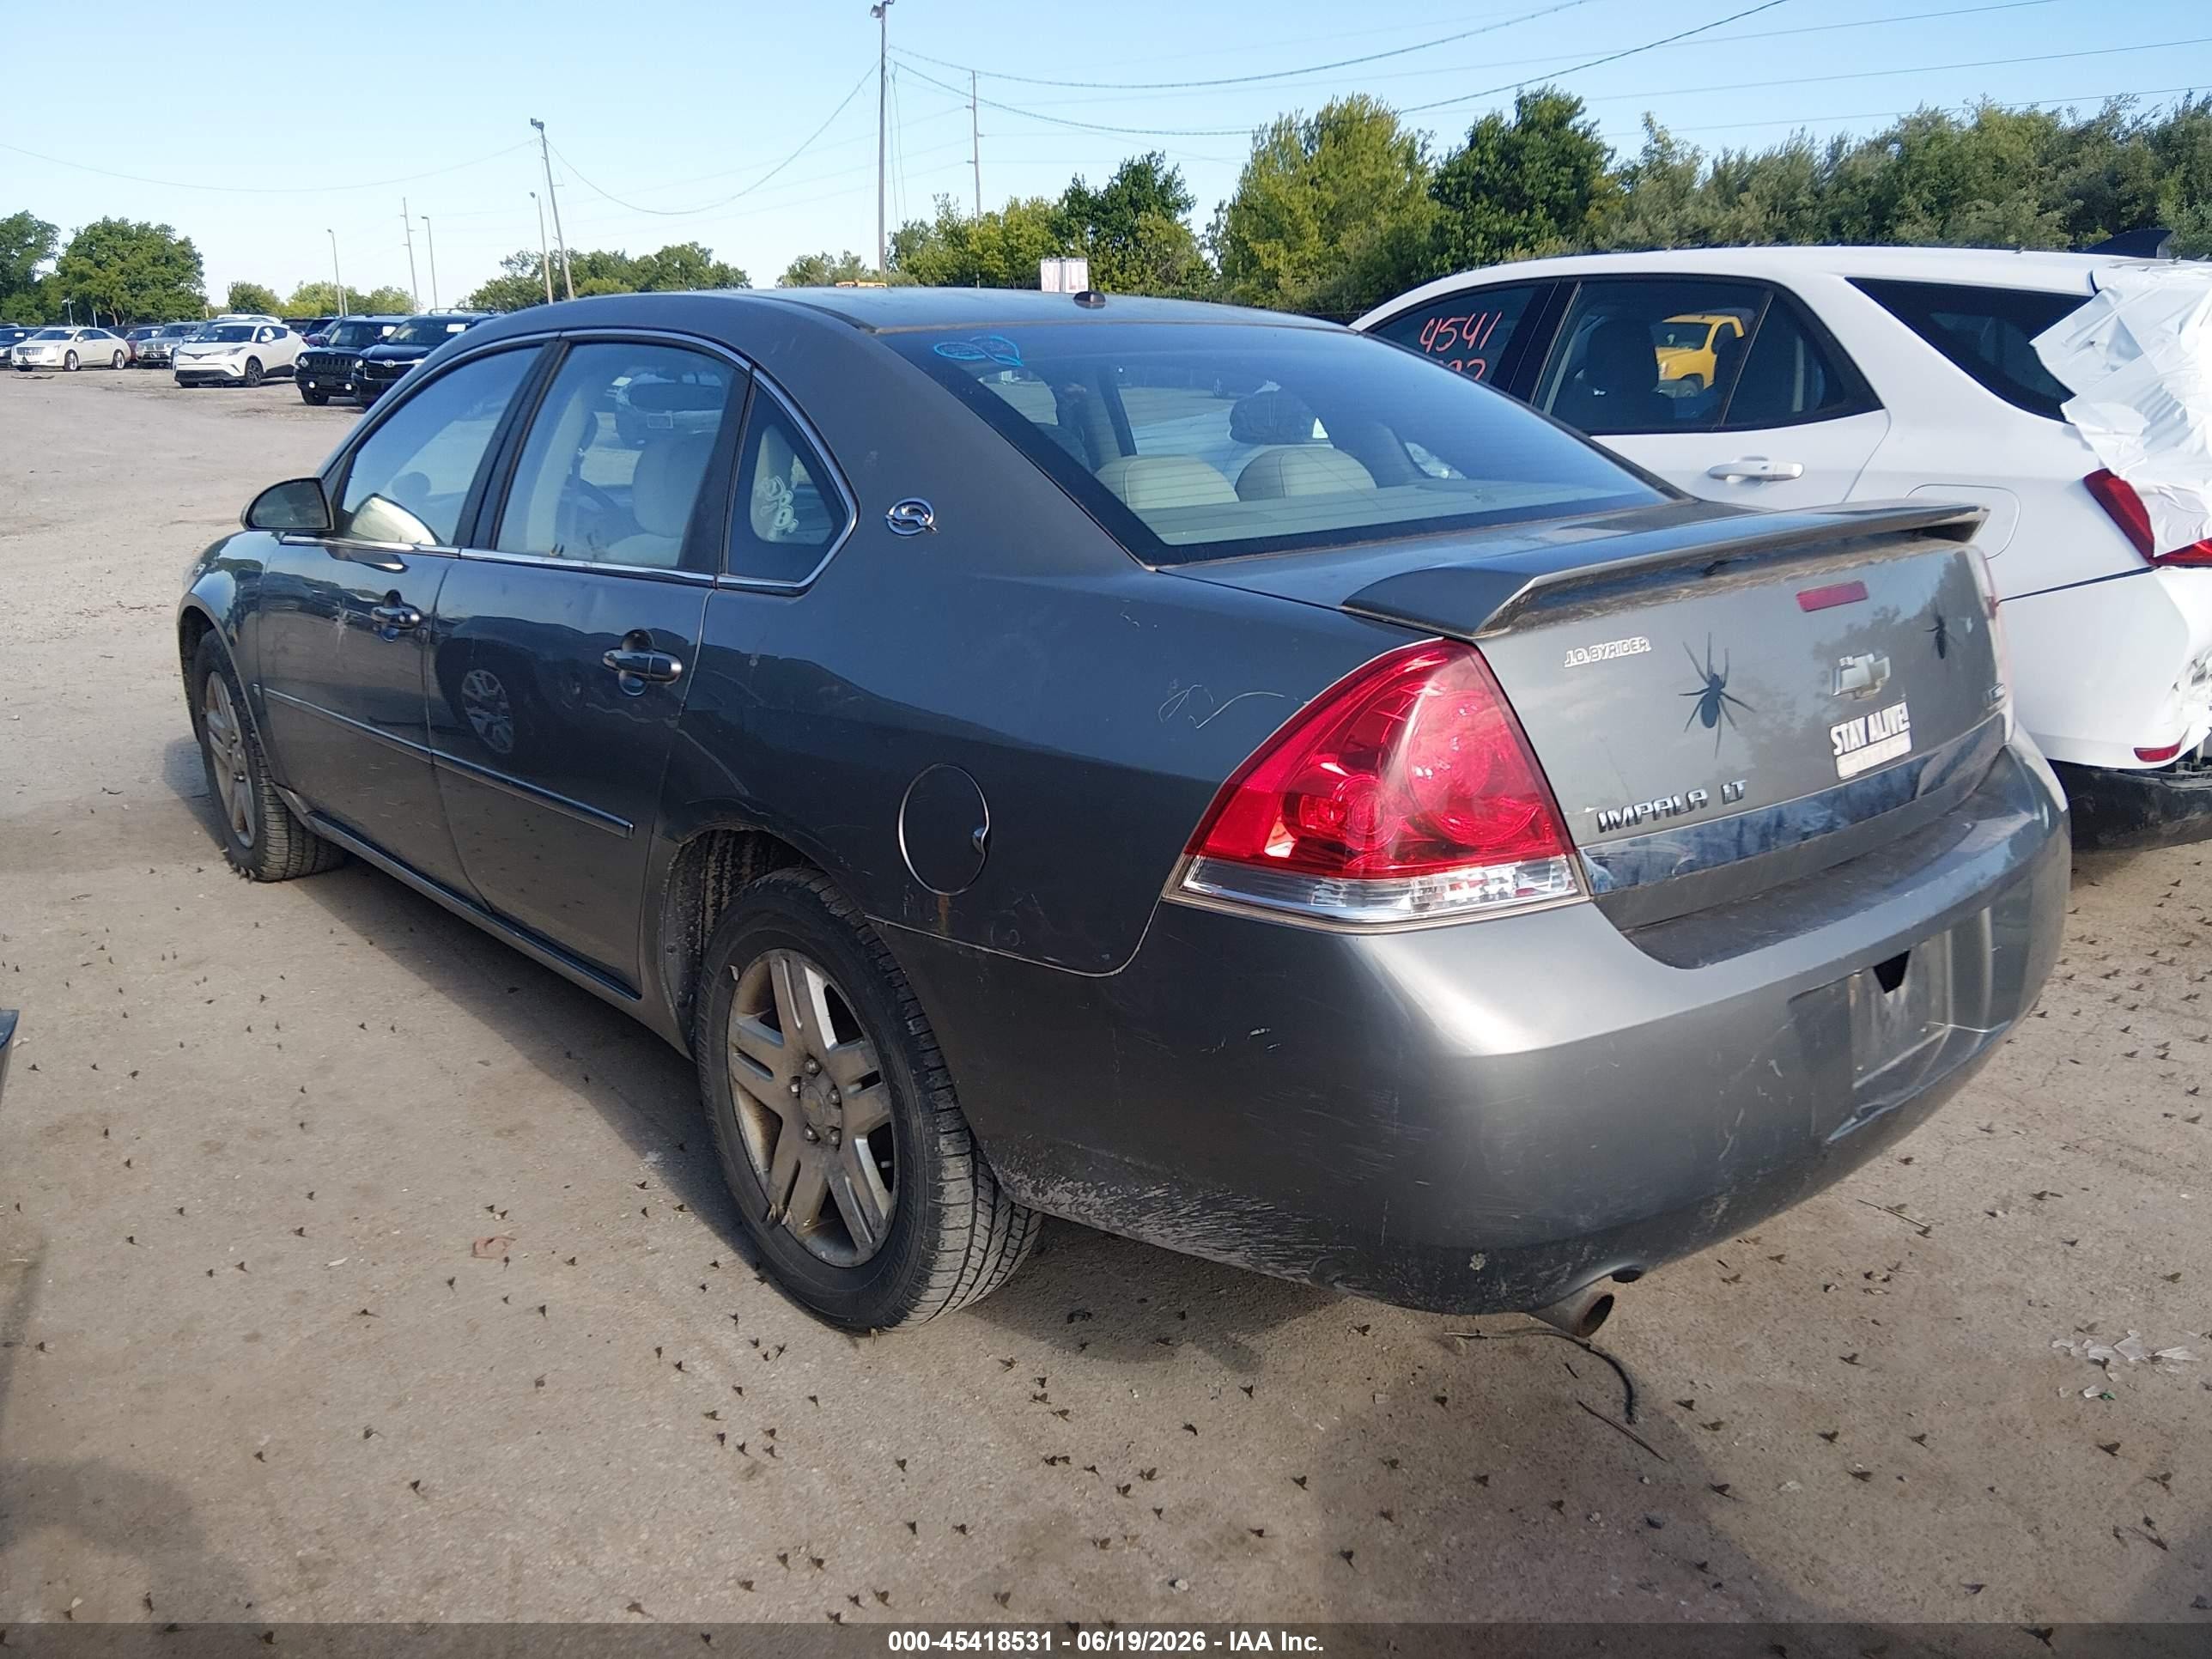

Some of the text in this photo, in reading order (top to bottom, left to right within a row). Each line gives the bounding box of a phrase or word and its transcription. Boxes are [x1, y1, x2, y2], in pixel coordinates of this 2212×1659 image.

[1419, 311, 1503, 354] 4541
[1830, 716, 1867, 756] STAY
[1597, 779, 1747, 834] IMPALA LT
